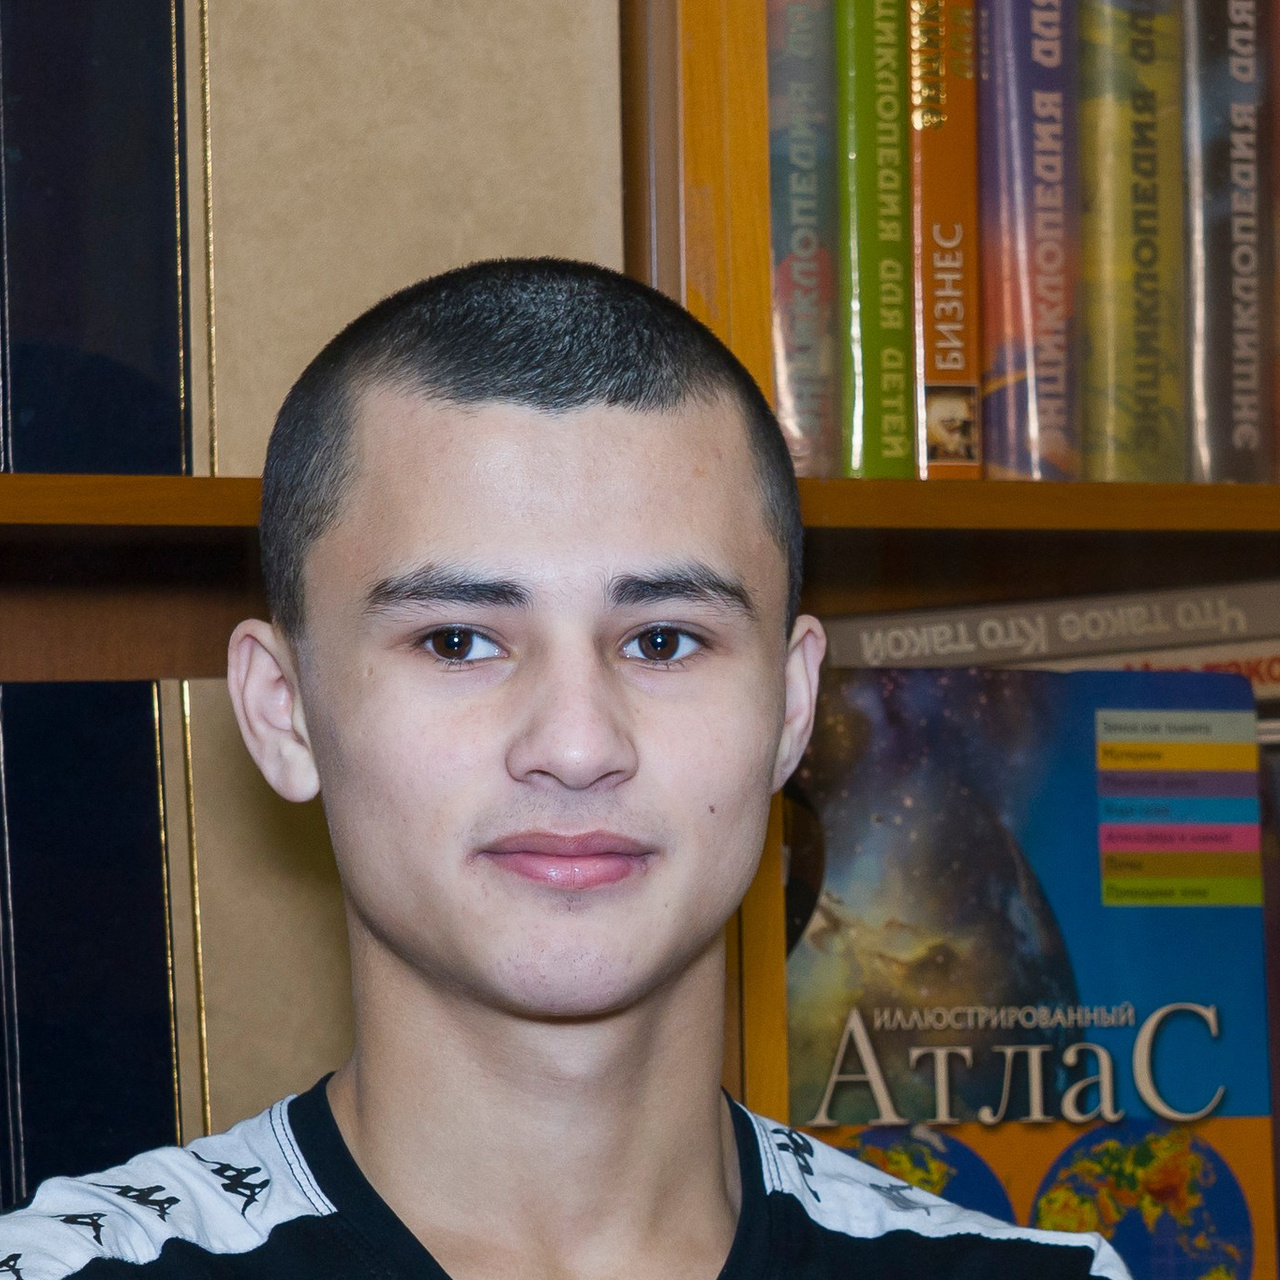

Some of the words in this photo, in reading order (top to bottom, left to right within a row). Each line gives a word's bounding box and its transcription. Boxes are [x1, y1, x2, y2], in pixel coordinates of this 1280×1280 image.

[879, 259, 904, 331] ДЛЯ
[933, 222, 965, 373] БИЗНЕС
[1032, 90, 1067, 450] ЭНЦИКЛОПЕДИЯ
[1131, 90, 1160, 450] ЭНЦИКЛОПЕДИЯ
[1229, 103, 1260, 452] ЭНЦИКЛОПЕДИЯ
[880, 346, 907, 460] ДЕТЕЙ
[860, 621, 974, 663] такой
[977, 614, 1051, 656] Кто
[1058, 604, 1170, 643] такое
[1175, 597, 1248, 633] Что
[873, 1003, 1135, 1031] ИЛЛЮСТРИРОВАННЫЙ
